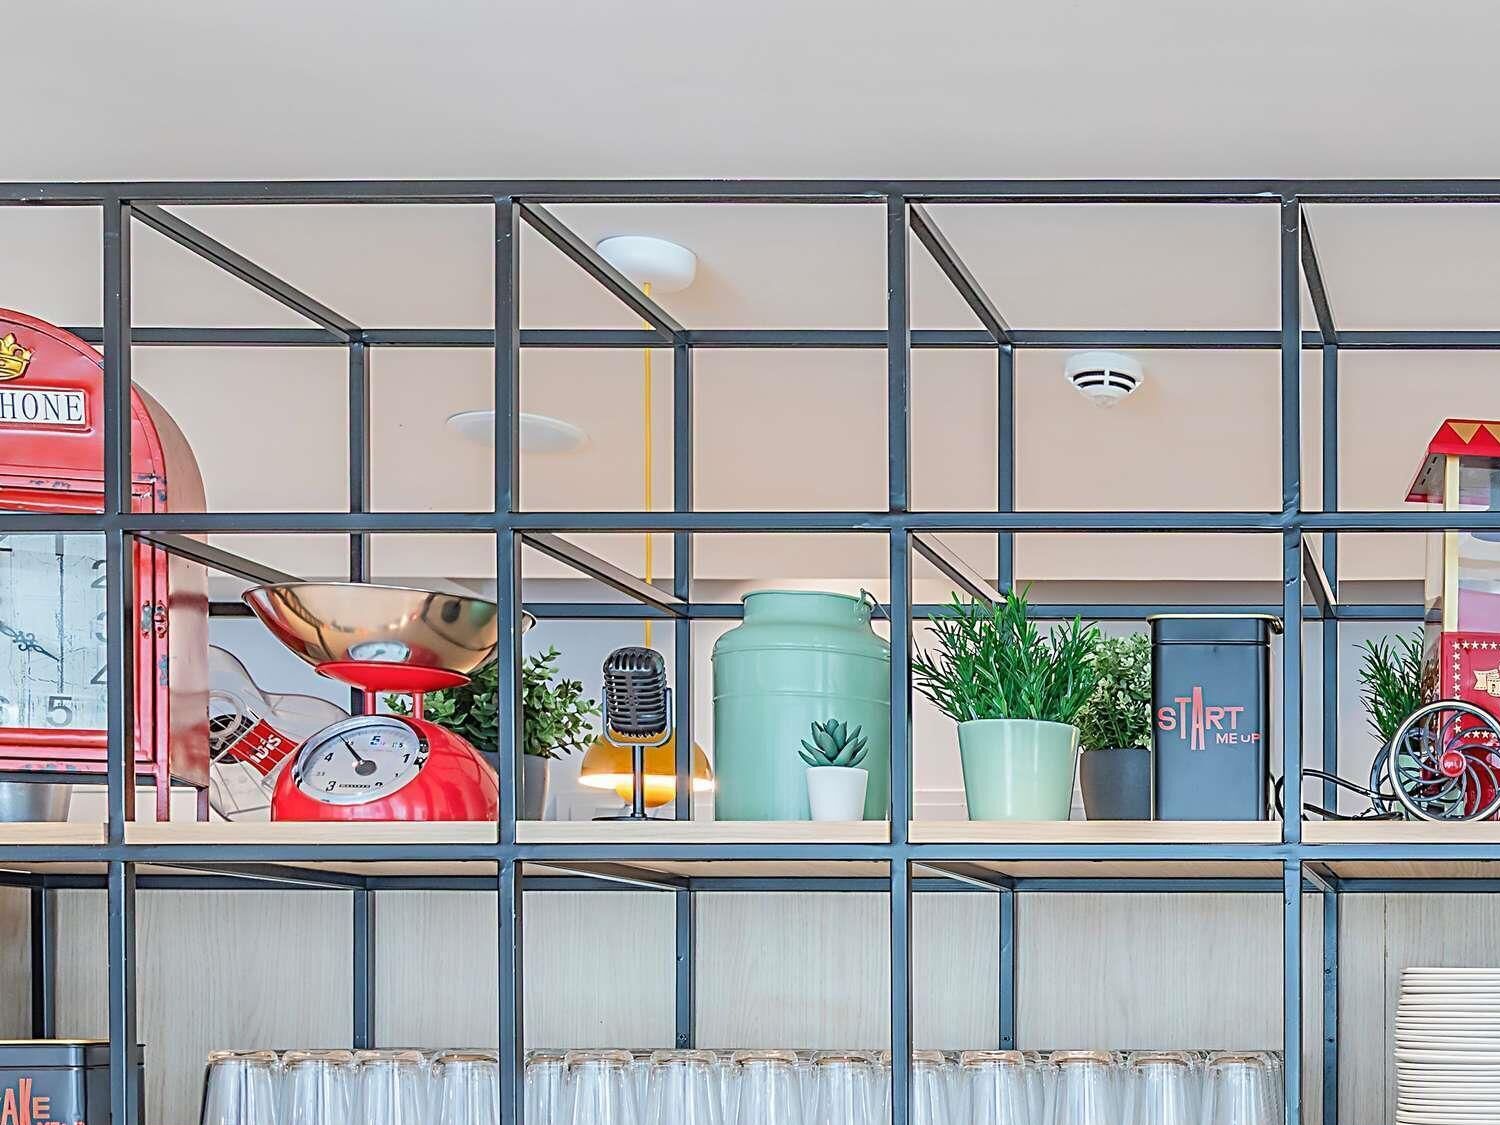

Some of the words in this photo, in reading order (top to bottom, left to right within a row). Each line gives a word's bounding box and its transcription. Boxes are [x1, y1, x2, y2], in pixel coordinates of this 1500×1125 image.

[0, 392, 83, 421] HONE
[46, 696, 73, 728] 5
[1157, 686, 1244, 751] START
[1216, 733, 1238, 744] ME
[1240, 733, 1262, 744] UP
